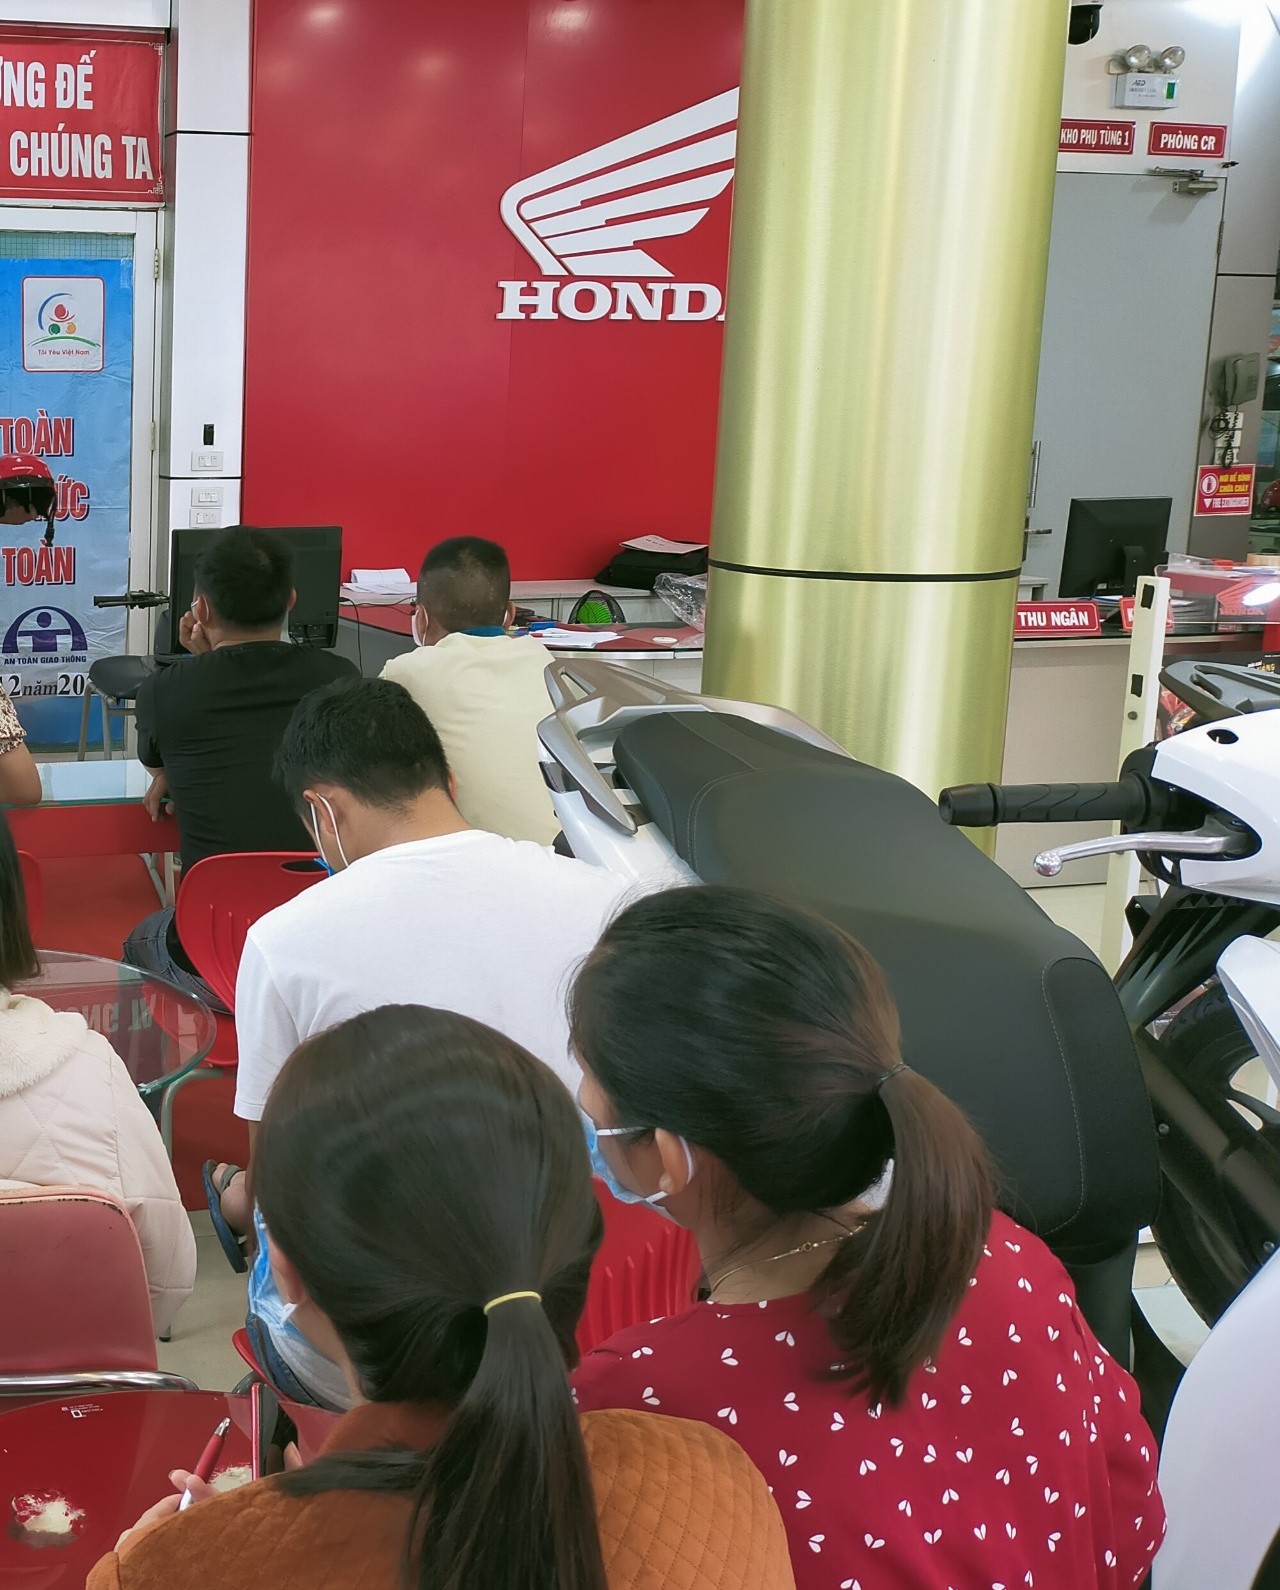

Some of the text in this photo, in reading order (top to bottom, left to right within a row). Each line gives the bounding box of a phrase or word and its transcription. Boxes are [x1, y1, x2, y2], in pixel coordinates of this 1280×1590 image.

[55, 50, 97, 110] ĐẾ
[1060, 125, 1129, 148] KHO PHỤ TÙNG 1
[1160, 130, 1216, 150] PHÒNG CR
[9, 122, 112, 179] CHÚNG
[121, 135, 154, 180] TA
[496, 280, 725, 320] HOND
[38, 348, 47, 356] Tôi
[48, 348, 60, 356] Yêu
[62, 348, 74, 357] Việt
[1, 539, 76, 586] TOÀN
[1018, 608, 1090, 627] THU NGÂN
[17, 656, 38, 664] TOÀN
[40, 656, 59, 664] GIAO
[62, 654, 87, 664] THÔNG
[22, 681, 58, 696] năm
